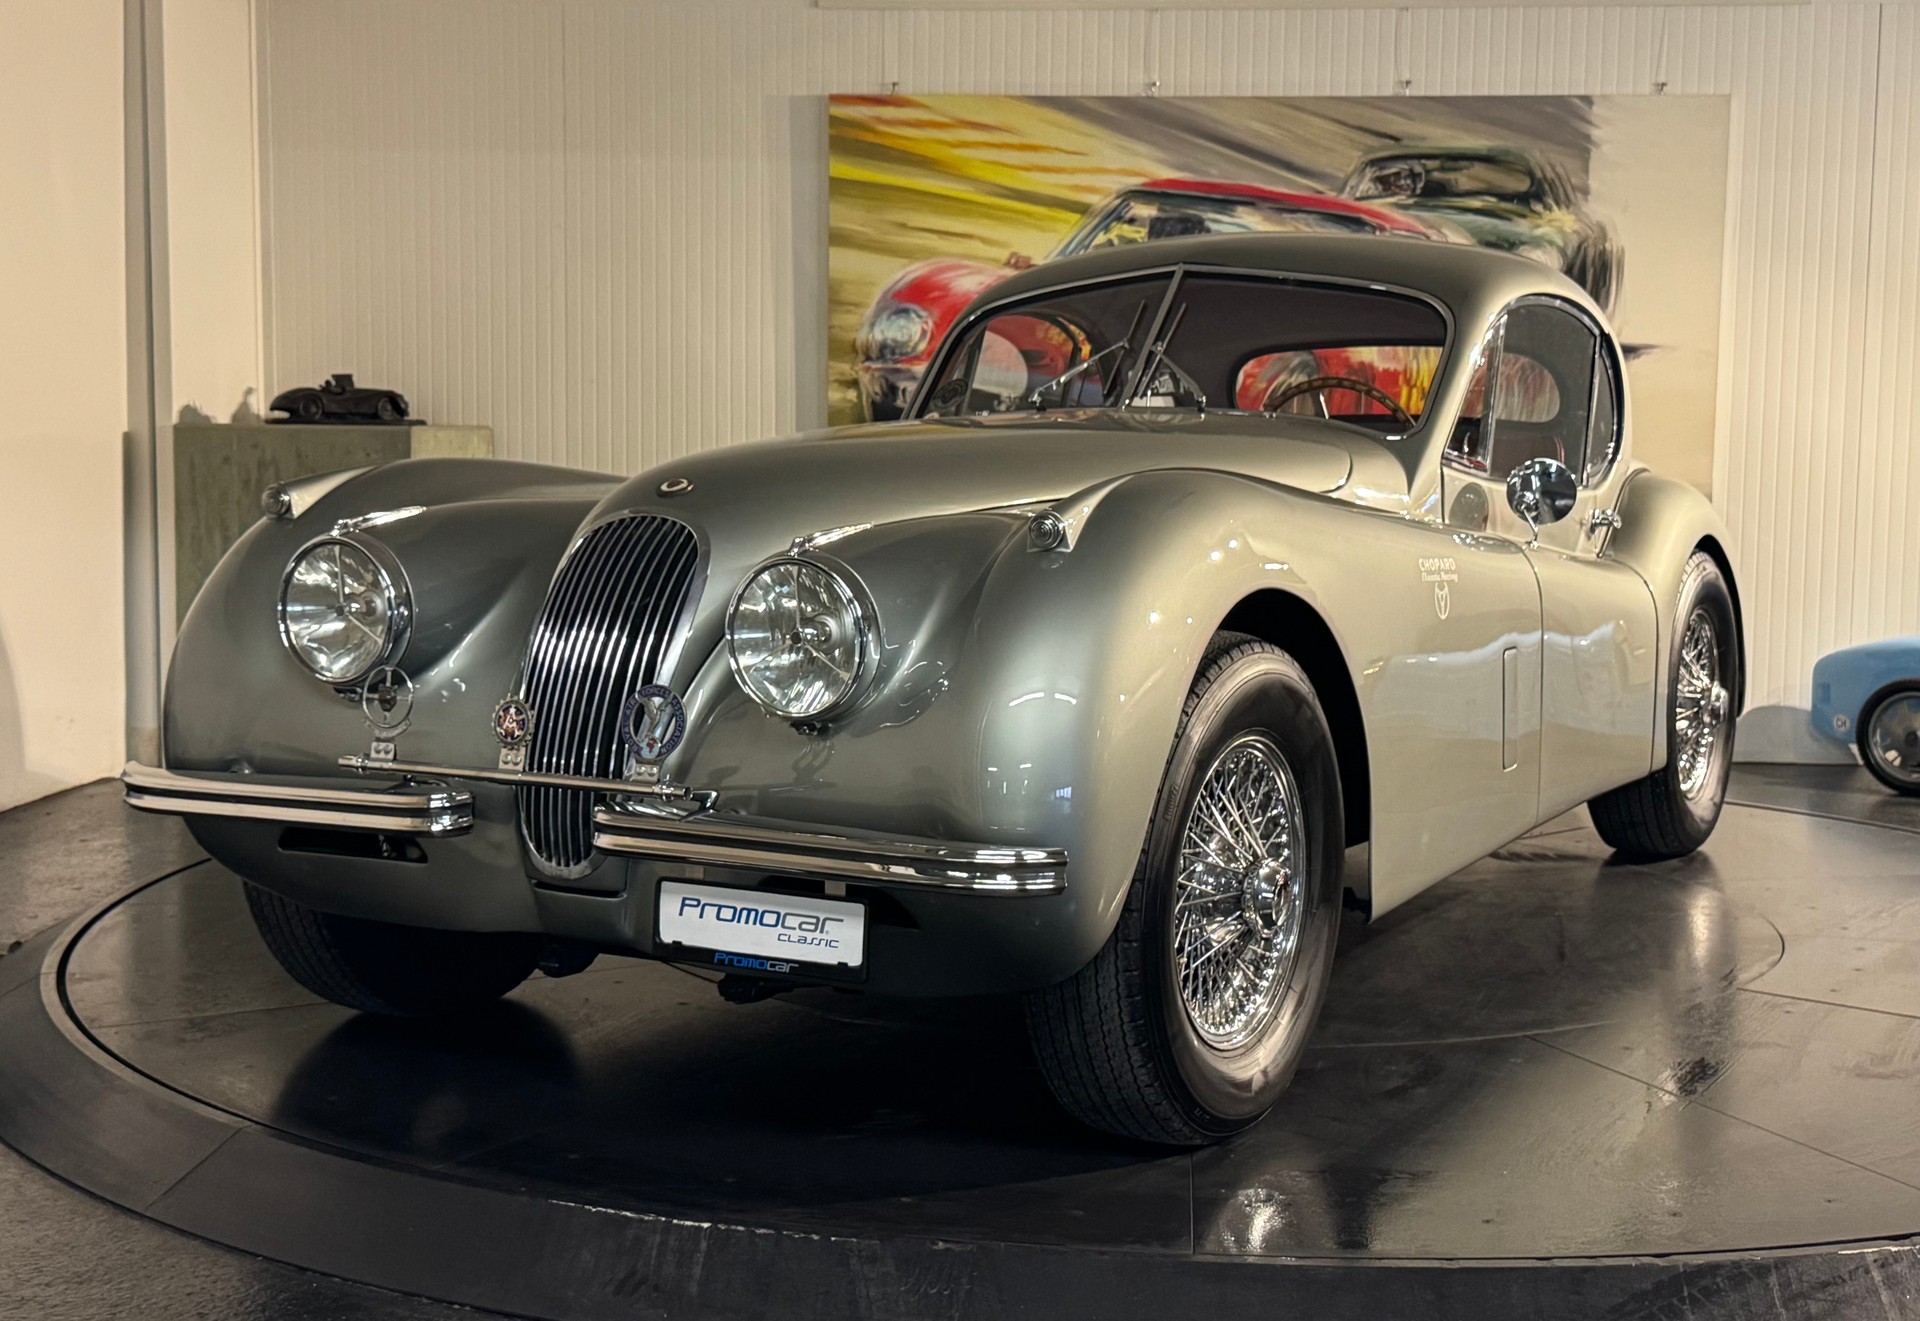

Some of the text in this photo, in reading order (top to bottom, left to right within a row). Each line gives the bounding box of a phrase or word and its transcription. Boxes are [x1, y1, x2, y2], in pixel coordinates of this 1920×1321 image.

[1418, 557, 1456, 572] CHOPARD
[661, 698, 684, 754] ASSOCIATION
[678, 896, 844, 935] Promocar
[713, 952, 799, 973] Promocar
